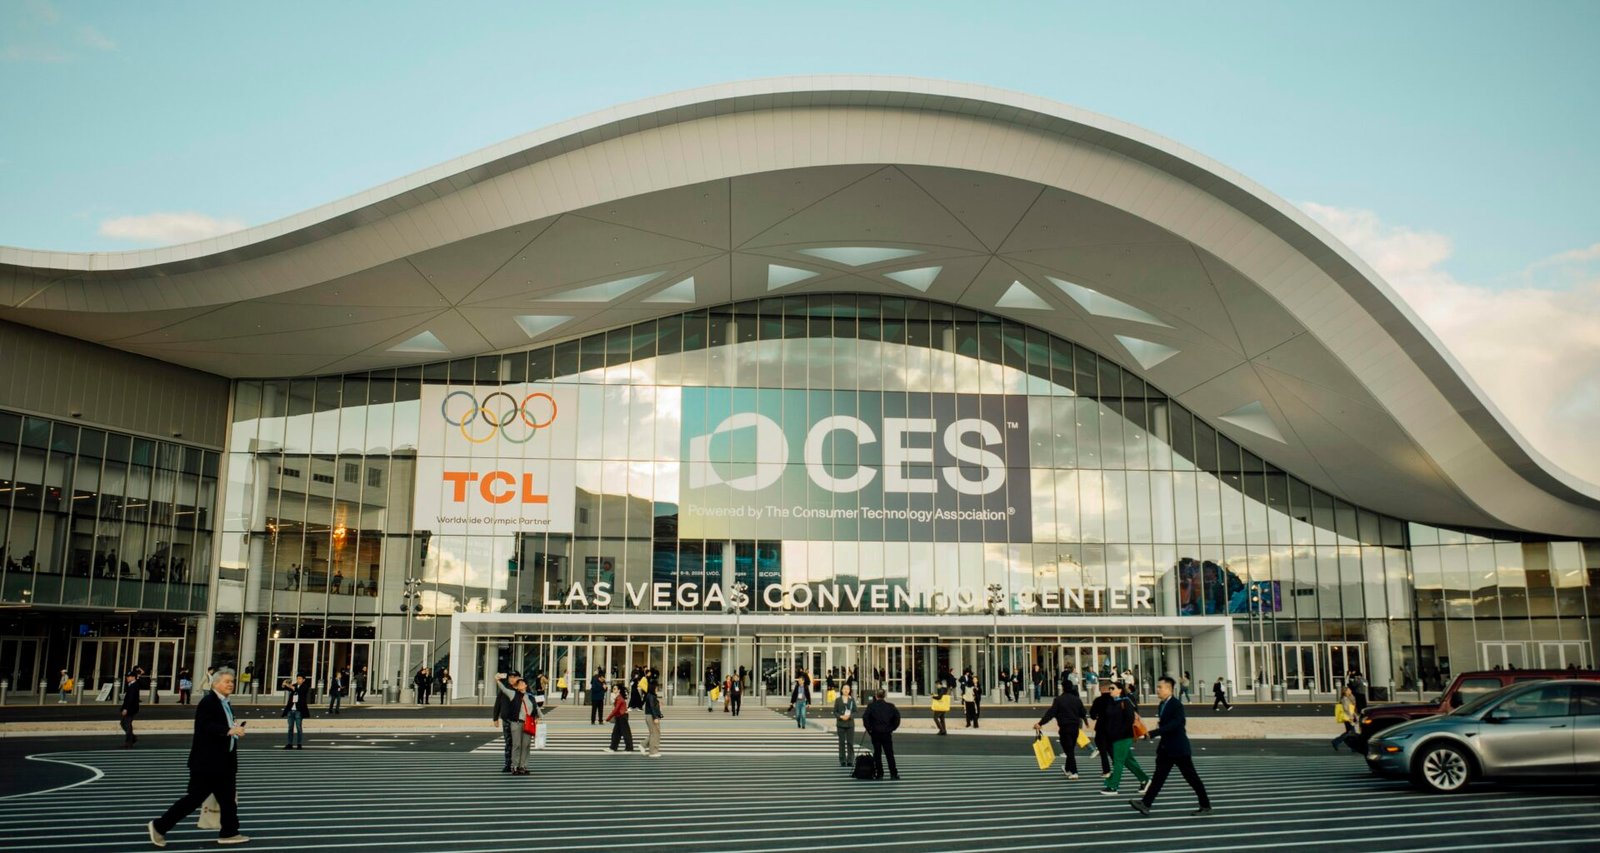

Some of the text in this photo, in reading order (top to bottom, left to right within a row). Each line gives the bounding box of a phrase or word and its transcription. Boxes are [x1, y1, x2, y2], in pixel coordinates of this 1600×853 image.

[443, 471, 549, 505] TCL
[436, 515, 552, 526] Worldwide Olympic Partner
[688, 504, 745, 518] Powered
[747, 505, 763, 520] by
[765, 505, 790, 518] The
[793, 506, 859, 519] Consumer
[861, 507, 933, 522] Technology
[543, 581, 612, 607] LAS
[625, 582, 750, 608] VEGAS
[1017, 585, 1152, 610] CENTER
